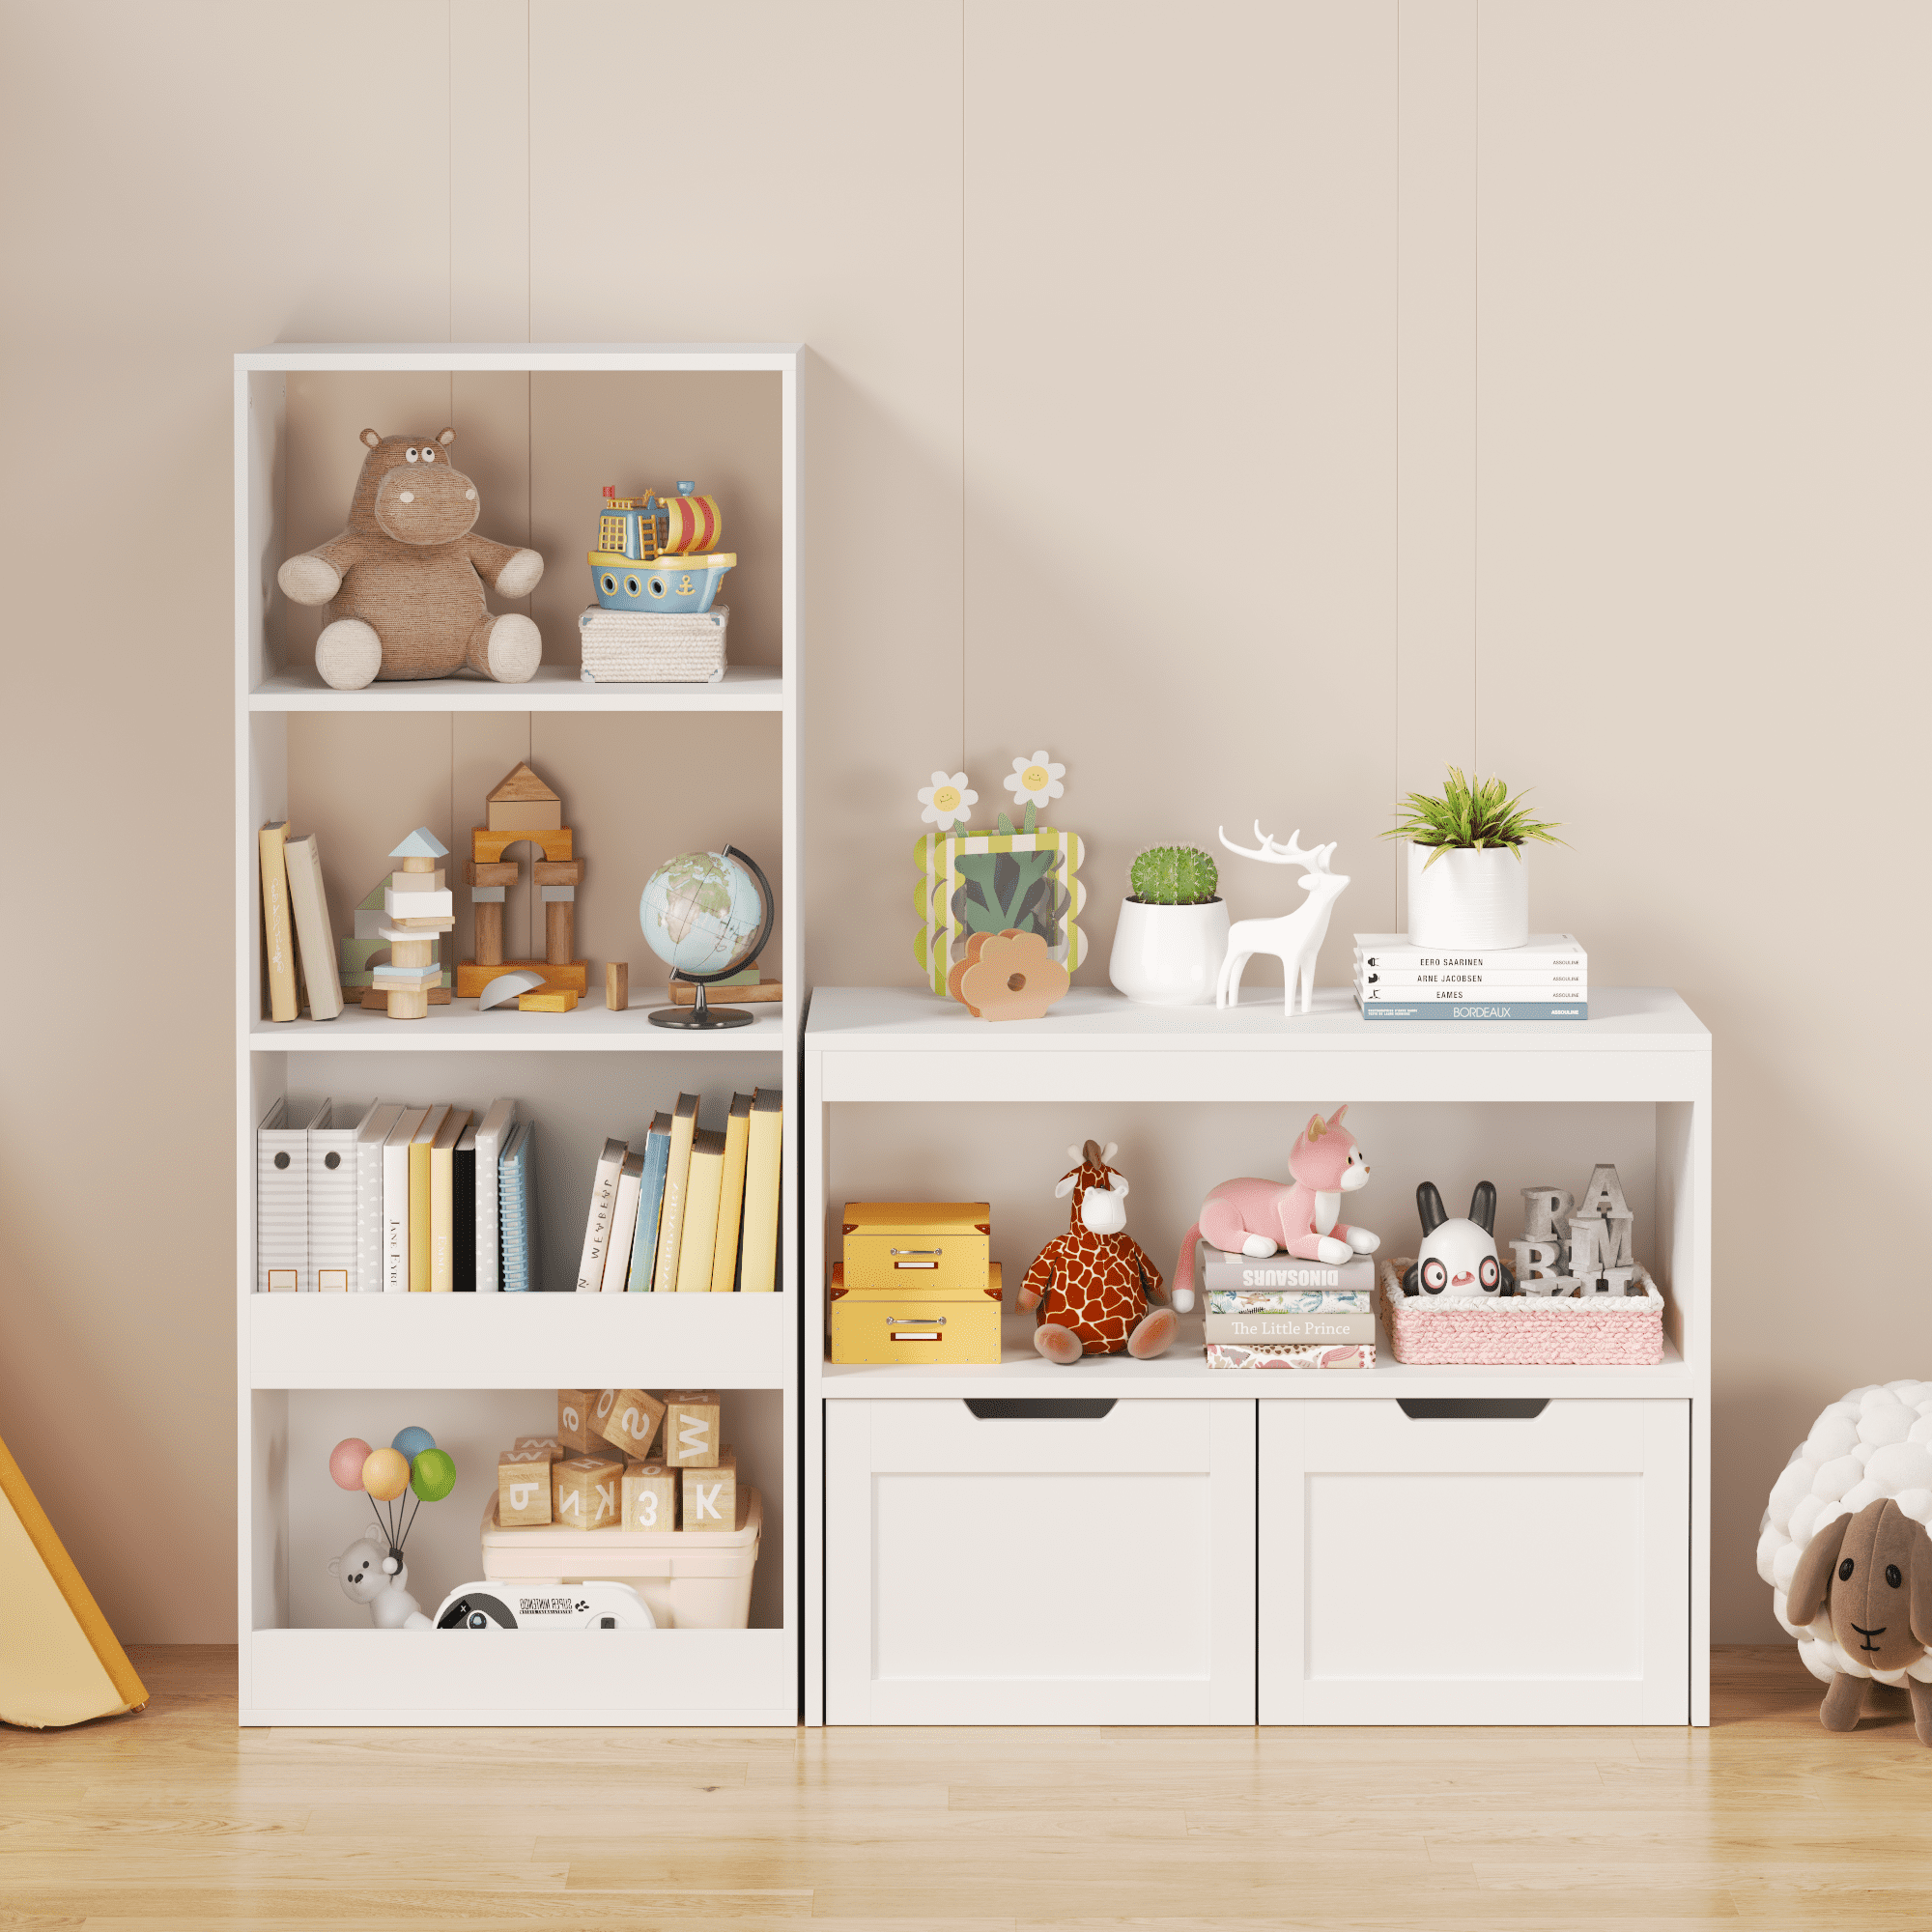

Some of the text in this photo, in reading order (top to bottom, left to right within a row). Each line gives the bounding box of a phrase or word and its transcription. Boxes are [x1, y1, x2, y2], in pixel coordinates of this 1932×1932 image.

[1453, 1008, 1511, 1018] BORDEAUX
[1242, 1269, 1339, 1286] DINOSAURS
[1232, 1321, 1350, 1335] The Little Prince
[696, 1483, 723, 1520] K
